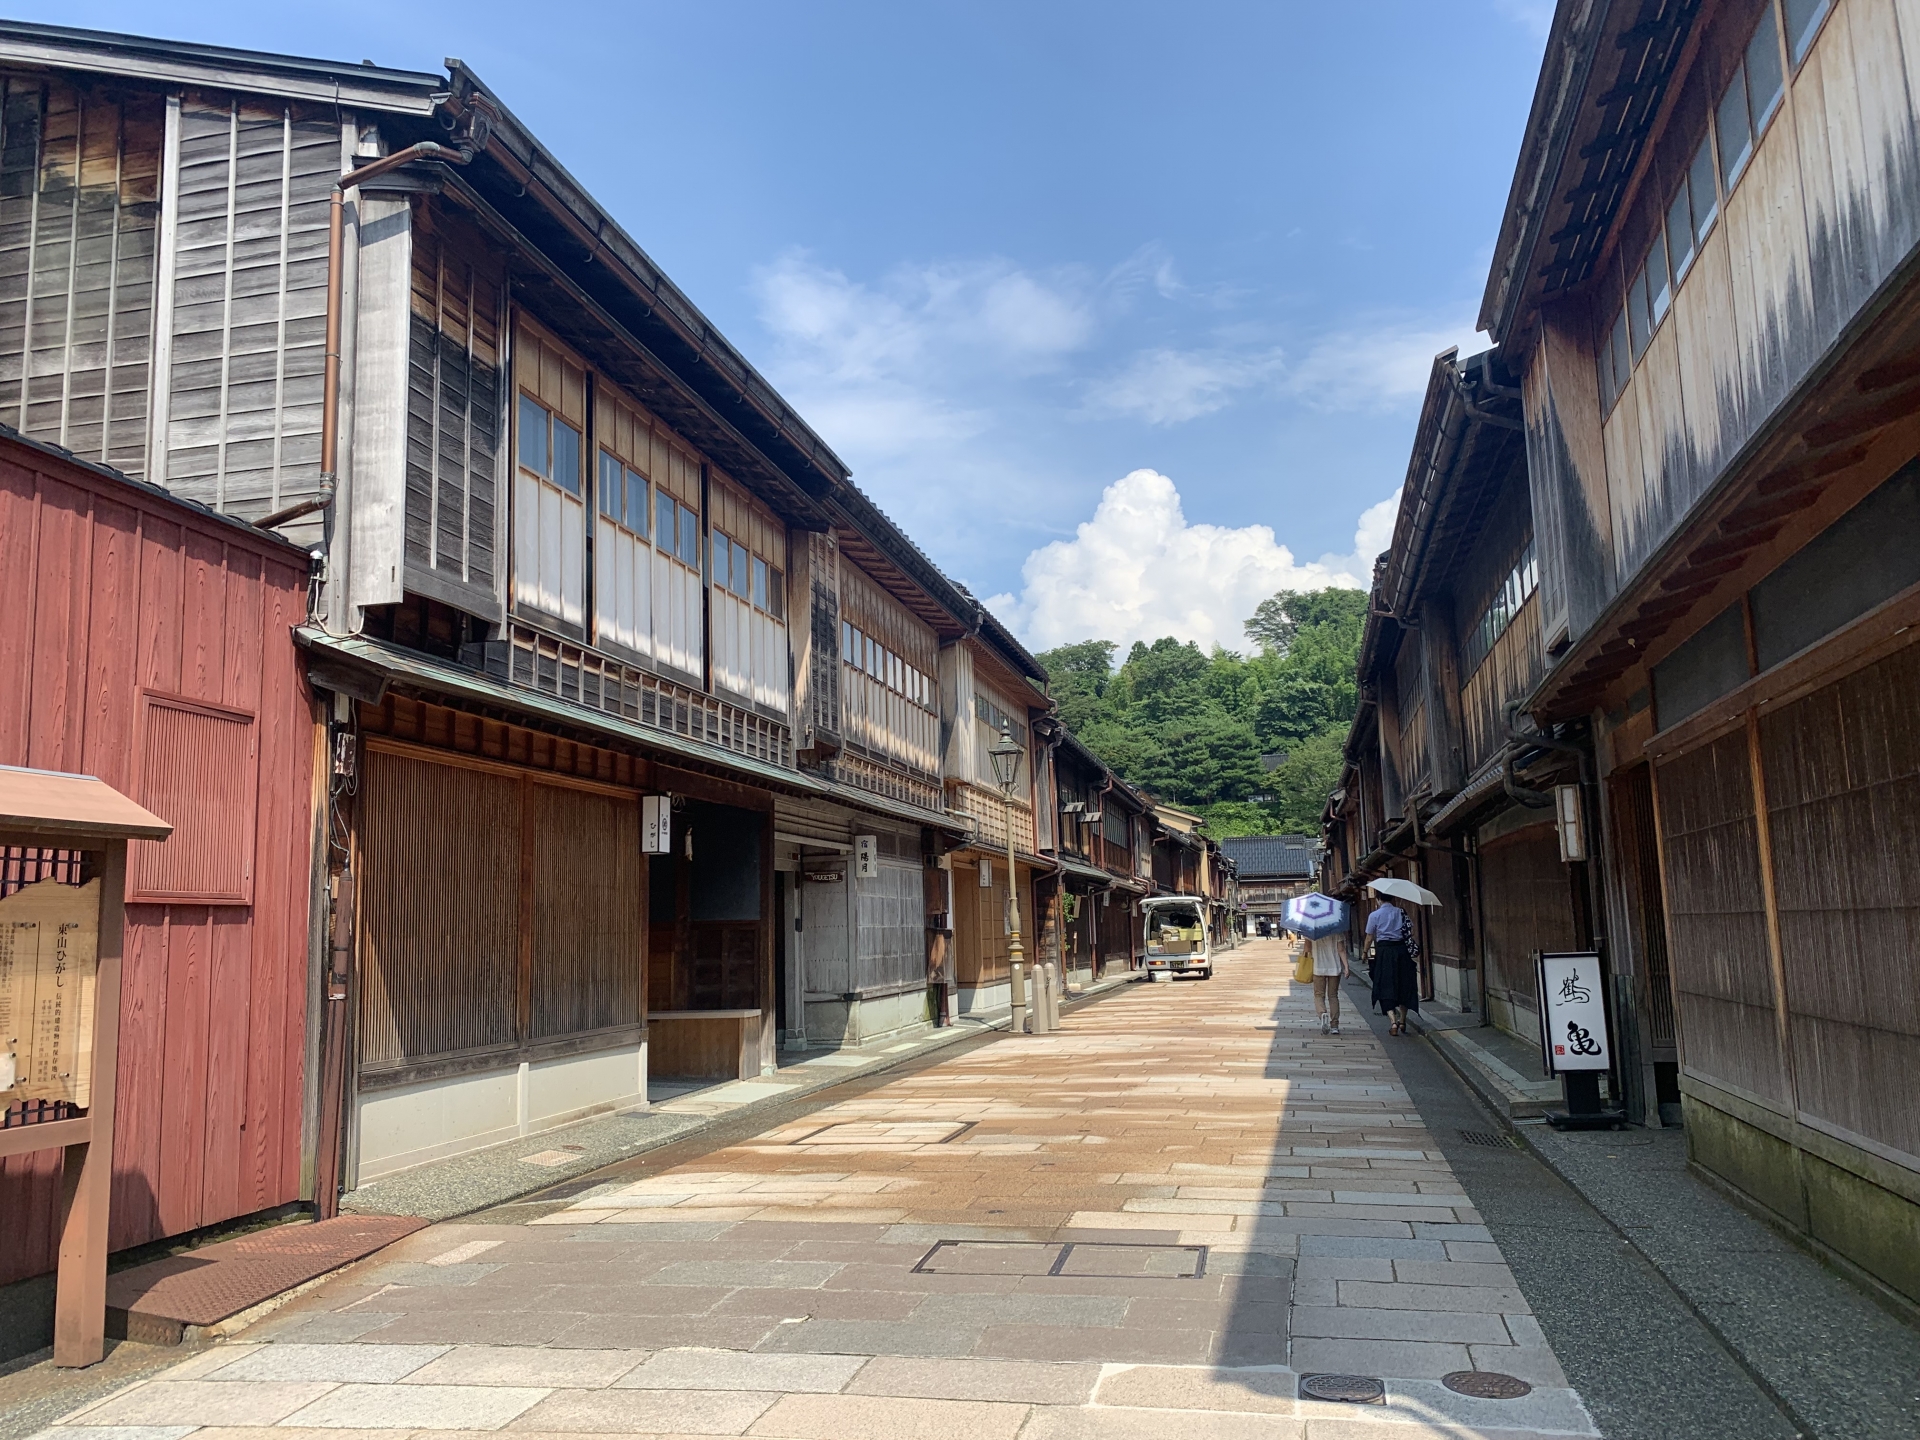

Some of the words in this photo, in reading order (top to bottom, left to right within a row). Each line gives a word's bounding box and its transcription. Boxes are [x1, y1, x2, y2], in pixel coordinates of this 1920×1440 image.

[649, 822, 657, 849] ひがし
[55, 923, 68, 988] 東山ひがし
